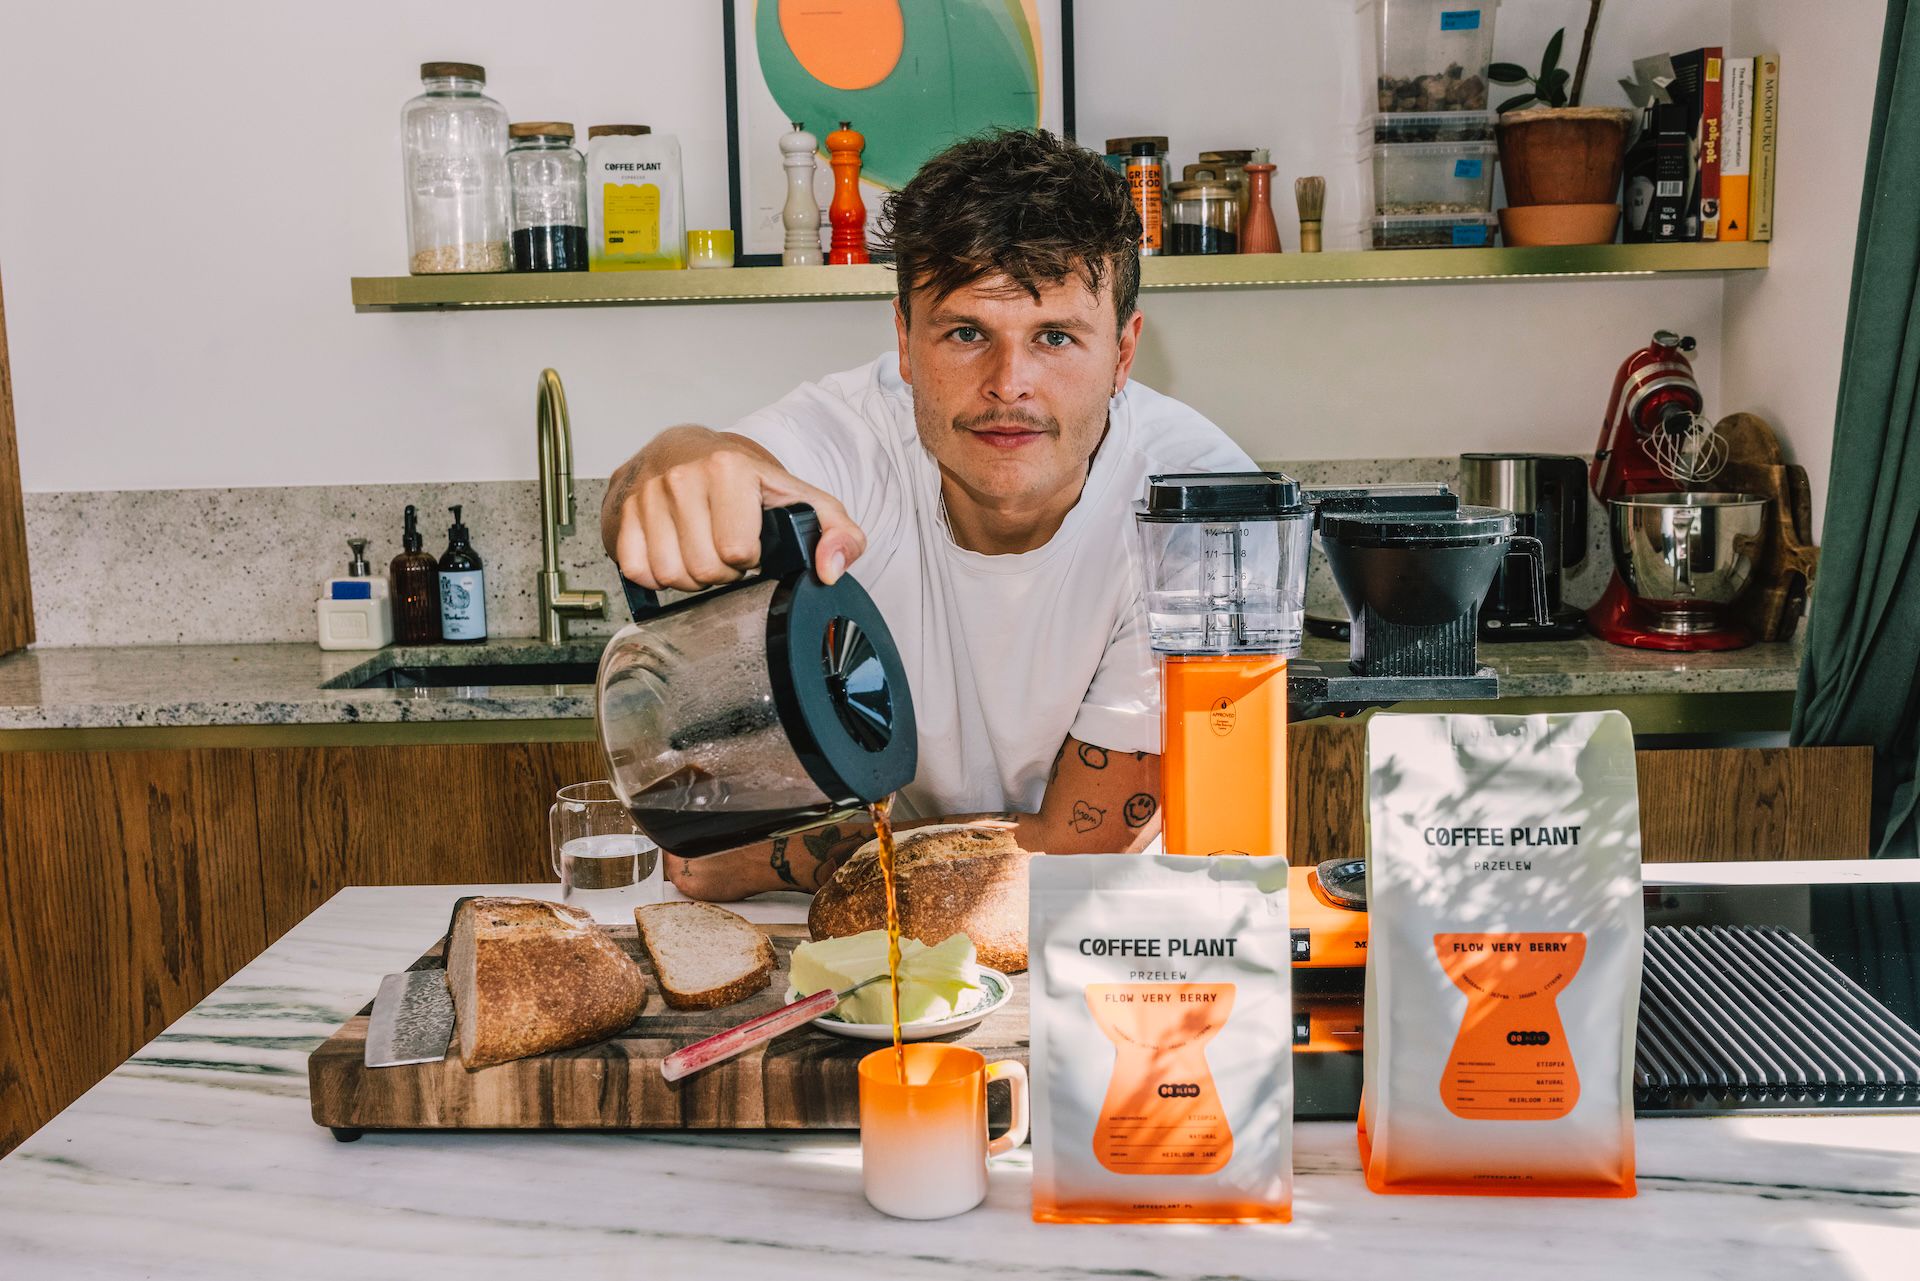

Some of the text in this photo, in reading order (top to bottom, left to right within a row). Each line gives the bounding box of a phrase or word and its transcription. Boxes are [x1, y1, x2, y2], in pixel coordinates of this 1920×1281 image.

[1762, 80, 1774, 153] MOMOFUKU
[636, 162, 661, 171] PLANT
[1510, 826, 1581, 847] PLANT
[1474, 861, 1532, 871] PRZELEW
[1168, 938, 1238, 957] PLANT
[1453, 943, 1567, 952] FLOW VERY BERRY
[1129, 971, 1188, 981] PRZELEW
[1105, 993, 1217, 1003] FLOW VERY BERRY
